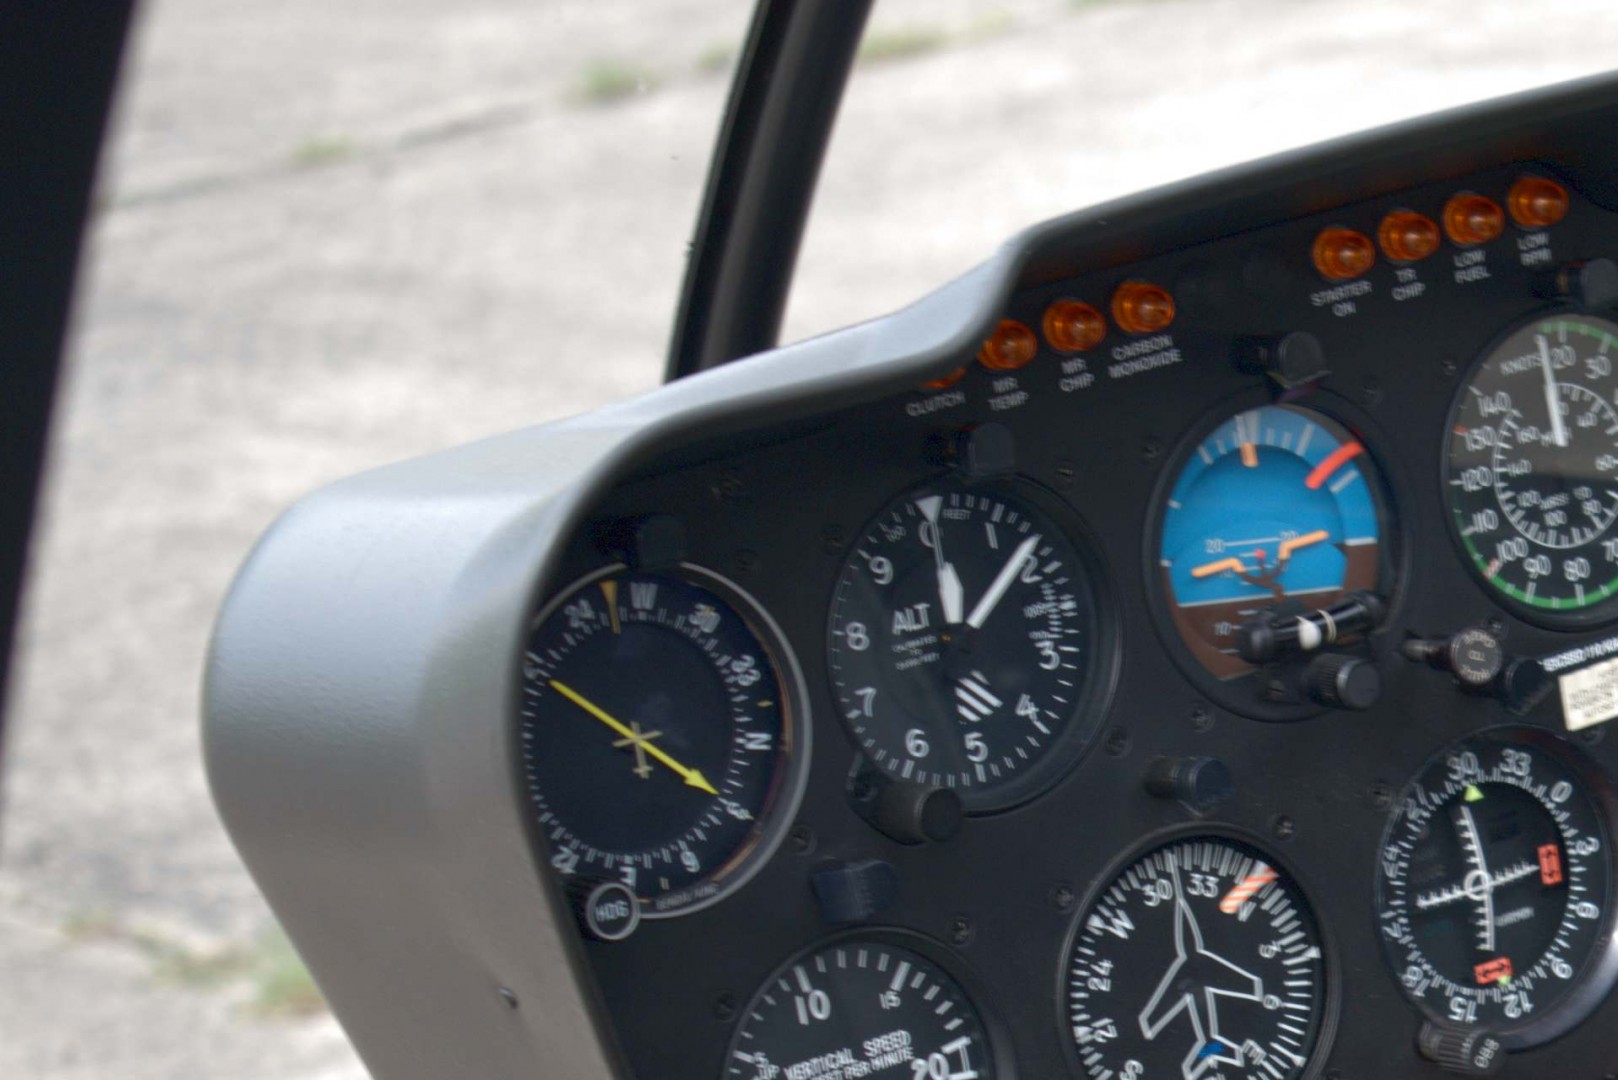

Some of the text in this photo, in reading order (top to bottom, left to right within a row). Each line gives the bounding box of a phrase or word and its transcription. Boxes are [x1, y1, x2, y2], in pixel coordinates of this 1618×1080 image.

[1517, 232, 1549, 250] LOW
[1453, 249, 1486, 267] LOW
[1310, 280, 1372, 306] STARTER
[1332, 302, 1356, 317] ON
[1112, 334, 1173, 360] CARBON
[1551, 345, 1577, 368] 20
[1107, 348, 1183, 378] MONOXIDE
[1500, 352, 1543, 376] KNOTS
[1584, 355, 1612, 380] 30
[905, 391, 965, 416] CLUTCH
[1477, 391, 1512, 417] 140
[1464, 425, 1497, 452] 130
[1460, 466, 1493, 492] 120
[1472, 508, 1499, 532] 110
[985, 522, 999, 550] 1
[1496, 537, 1529, 562] 100
[869, 556, 894, 585] 9
[1020, 554, 1043, 583] 2
[1523, 554, 1552, 579] 90
[1563, 557, 1591, 582] 80
[630, 582, 657, 610] W
[564, 600, 595, 630] 24
[689, 603, 720, 633] 30
[892, 603, 931, 635] ALT
[845, 621, 870, 651] 8
[1034, 640, 1060, 671] 3
[731, 654, 761, 687] 33
[854, 686, 877, 717] 7
[1015, 694, 1039, 720] 4
[744, 733, 771, 751] N
[905, 728, 929, 758] 6
[964, 731, 989, 762] 5
[1446, 752, 1479, 781] 30
[1500, 749, 1532, 777] 33
[1550, 781, 1573, 803] 0
[1576, 837, 1599, 856] 3
[552, 847, 580, 874] 12
[680, 850, 700, 872] 6
[1142, 879, 1172, 907] 30
[1188, 873, 1219, 898] 33
[1575, 902, 1599, 919] 6
[1101, 909, 1136, 939] W
[1088, 958, 1114, 992] 24
[1401, 965, 1426, 998] 18
[1551, 958, 1573, 980] 9
[794, 989, 831, 1025] 10
[879, 990, 901, 1010] 15
[1449, 997, 1478, 1023] 15
[1503, 991, 1535, 1019] 12
[863, 1029, 911, 1057] SPEED
[1241, 1039, 1267, 1066] E
[753, 1052, 767, 1066] 5
[760, 1064, 780, 1080] UP
[844, 1061, 872, 1079] PER
[870, 1046, 915, 1071] MINUTE
